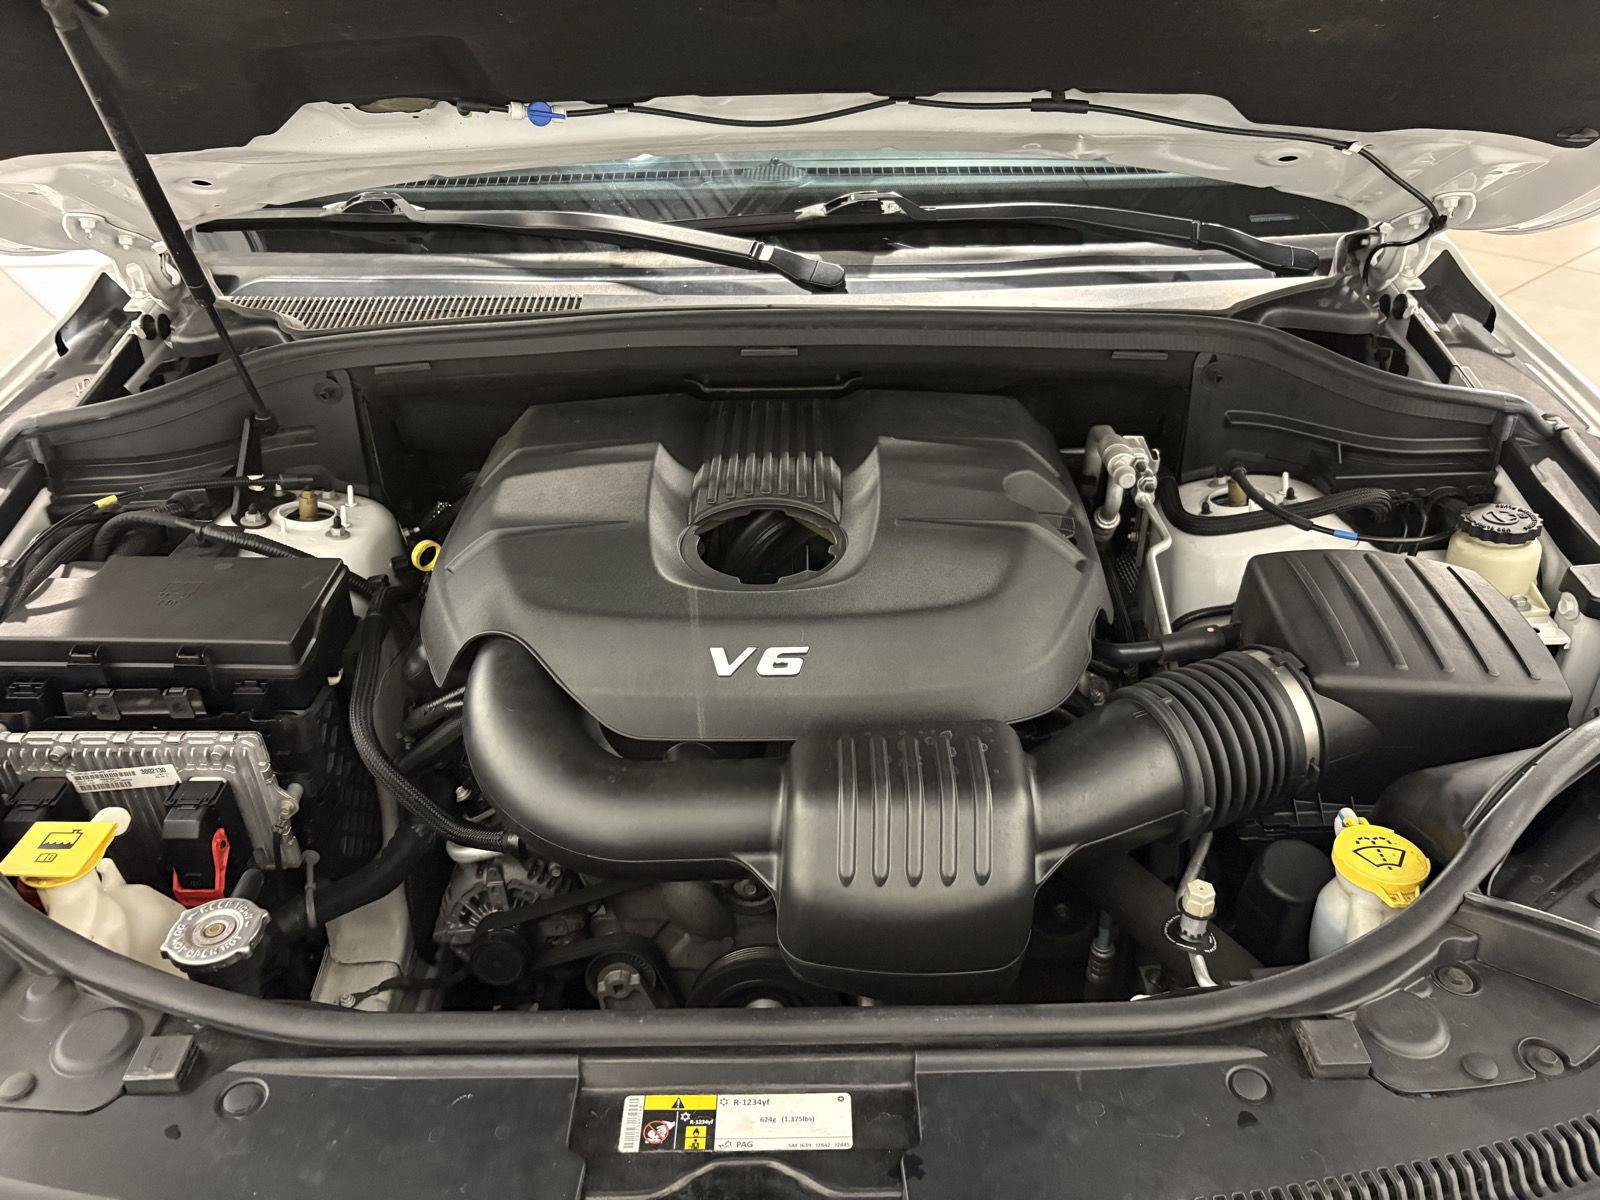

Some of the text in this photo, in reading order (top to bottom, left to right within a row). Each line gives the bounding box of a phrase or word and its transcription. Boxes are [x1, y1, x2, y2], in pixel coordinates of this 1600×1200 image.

[709, 646, 810, 677] V6
[733, 1098, 770, 1107] R-1234yf
[689, 1118, 714, 1126] R-1234yf
[781, 1115, 815, 1123] (1.375lbs)
[736, 1140, 753, 1148] PAG
